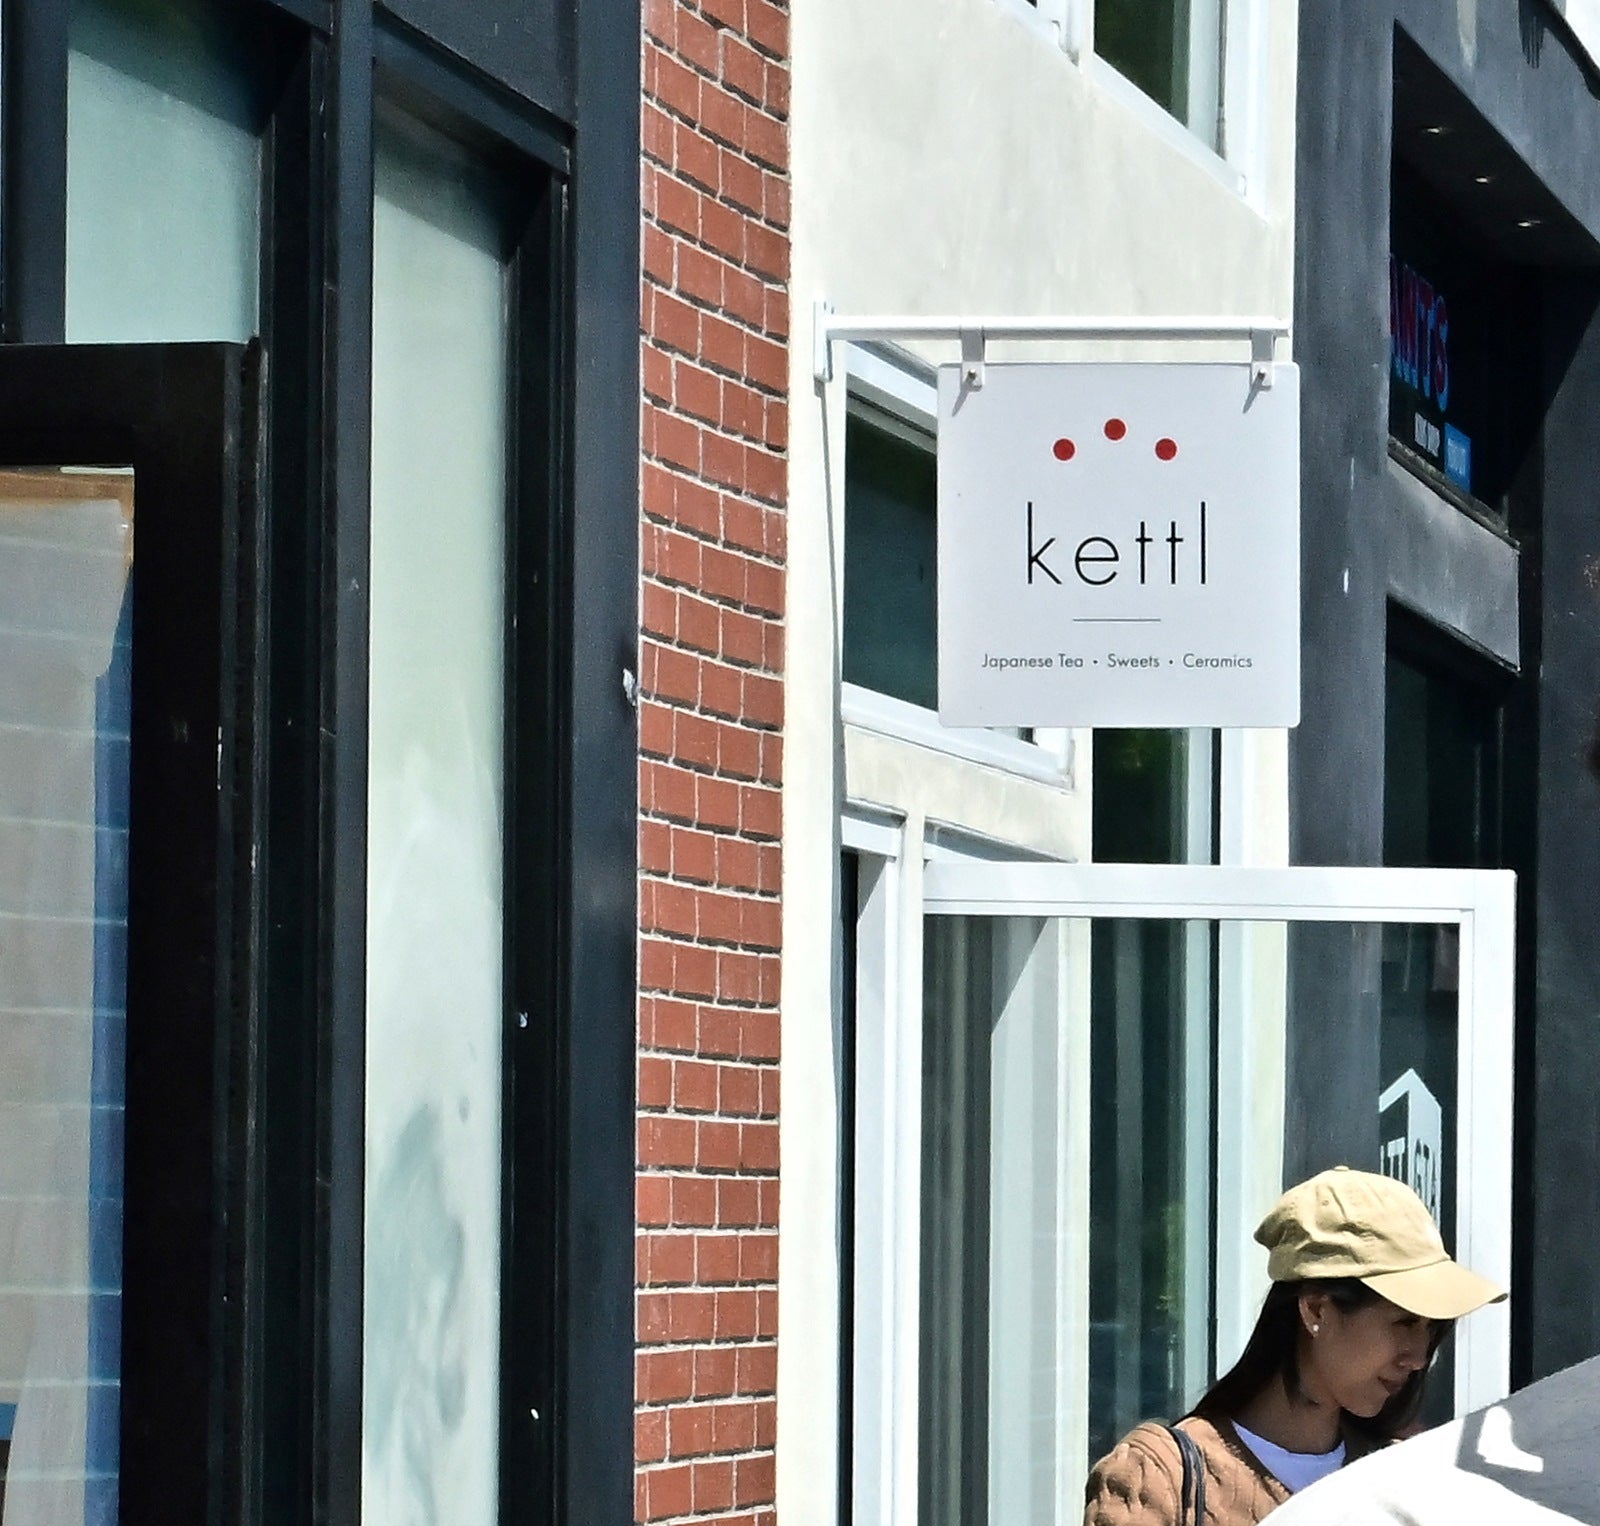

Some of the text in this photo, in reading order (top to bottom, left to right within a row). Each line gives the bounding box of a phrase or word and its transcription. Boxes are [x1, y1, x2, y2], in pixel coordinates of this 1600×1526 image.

[1027, 501, 1206, 586] kettl
[981, 652, 1253, 672] Japanese Tea Sweets Ceramics
